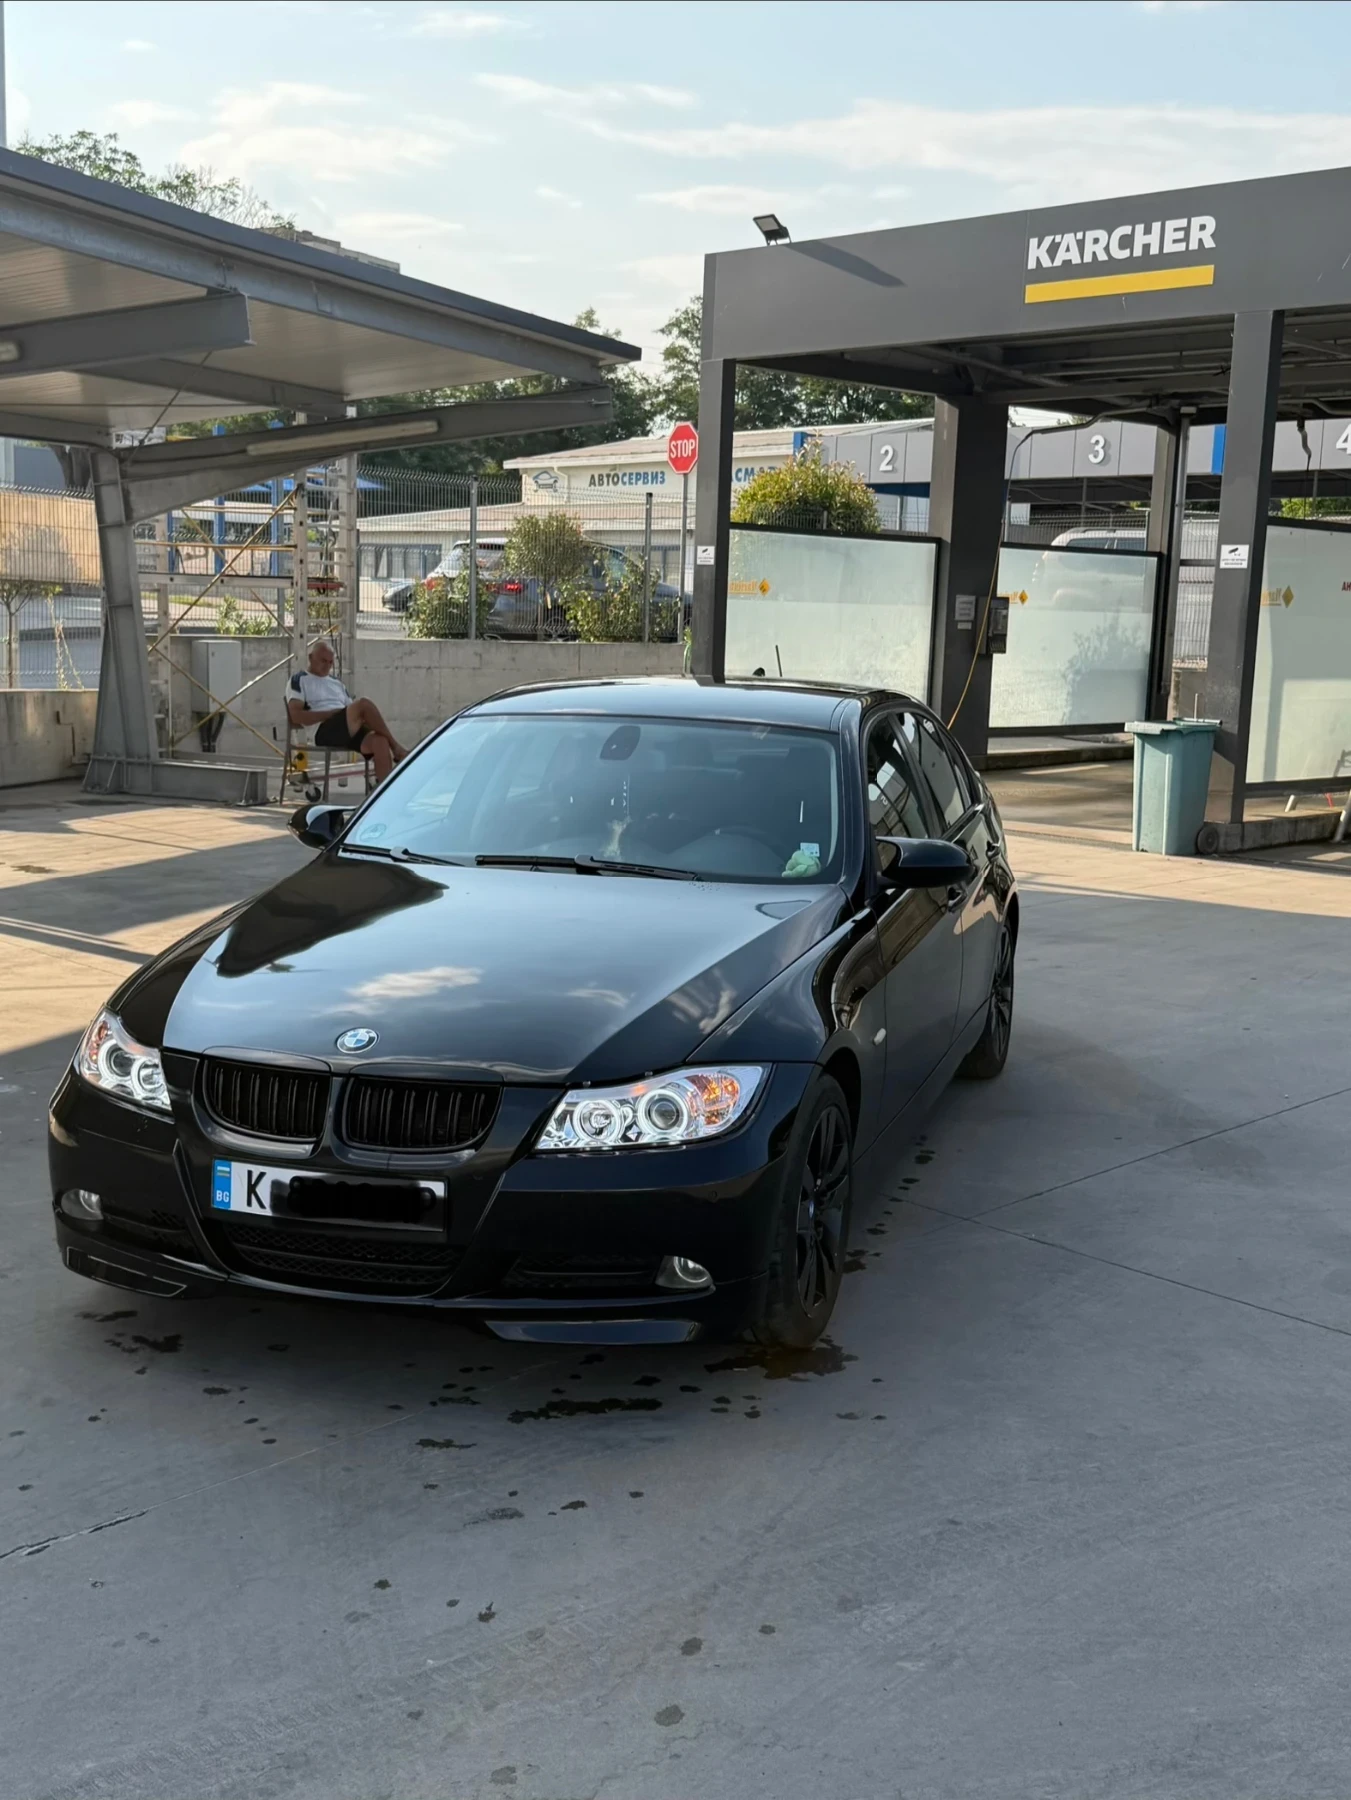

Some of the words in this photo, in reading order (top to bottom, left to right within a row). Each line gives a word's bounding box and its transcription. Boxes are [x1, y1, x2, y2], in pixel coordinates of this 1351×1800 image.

[1027, 215, 1216, 270] KÄRCHER
[670, 438, 696, 460] STOP
[880, 445, 893, 471] 2
[1088, 435, 1104, 463] 3
[589, 470, 666, 488] АВТОСЕРВИЗ
[216, 1190, 229, 1203] BG
